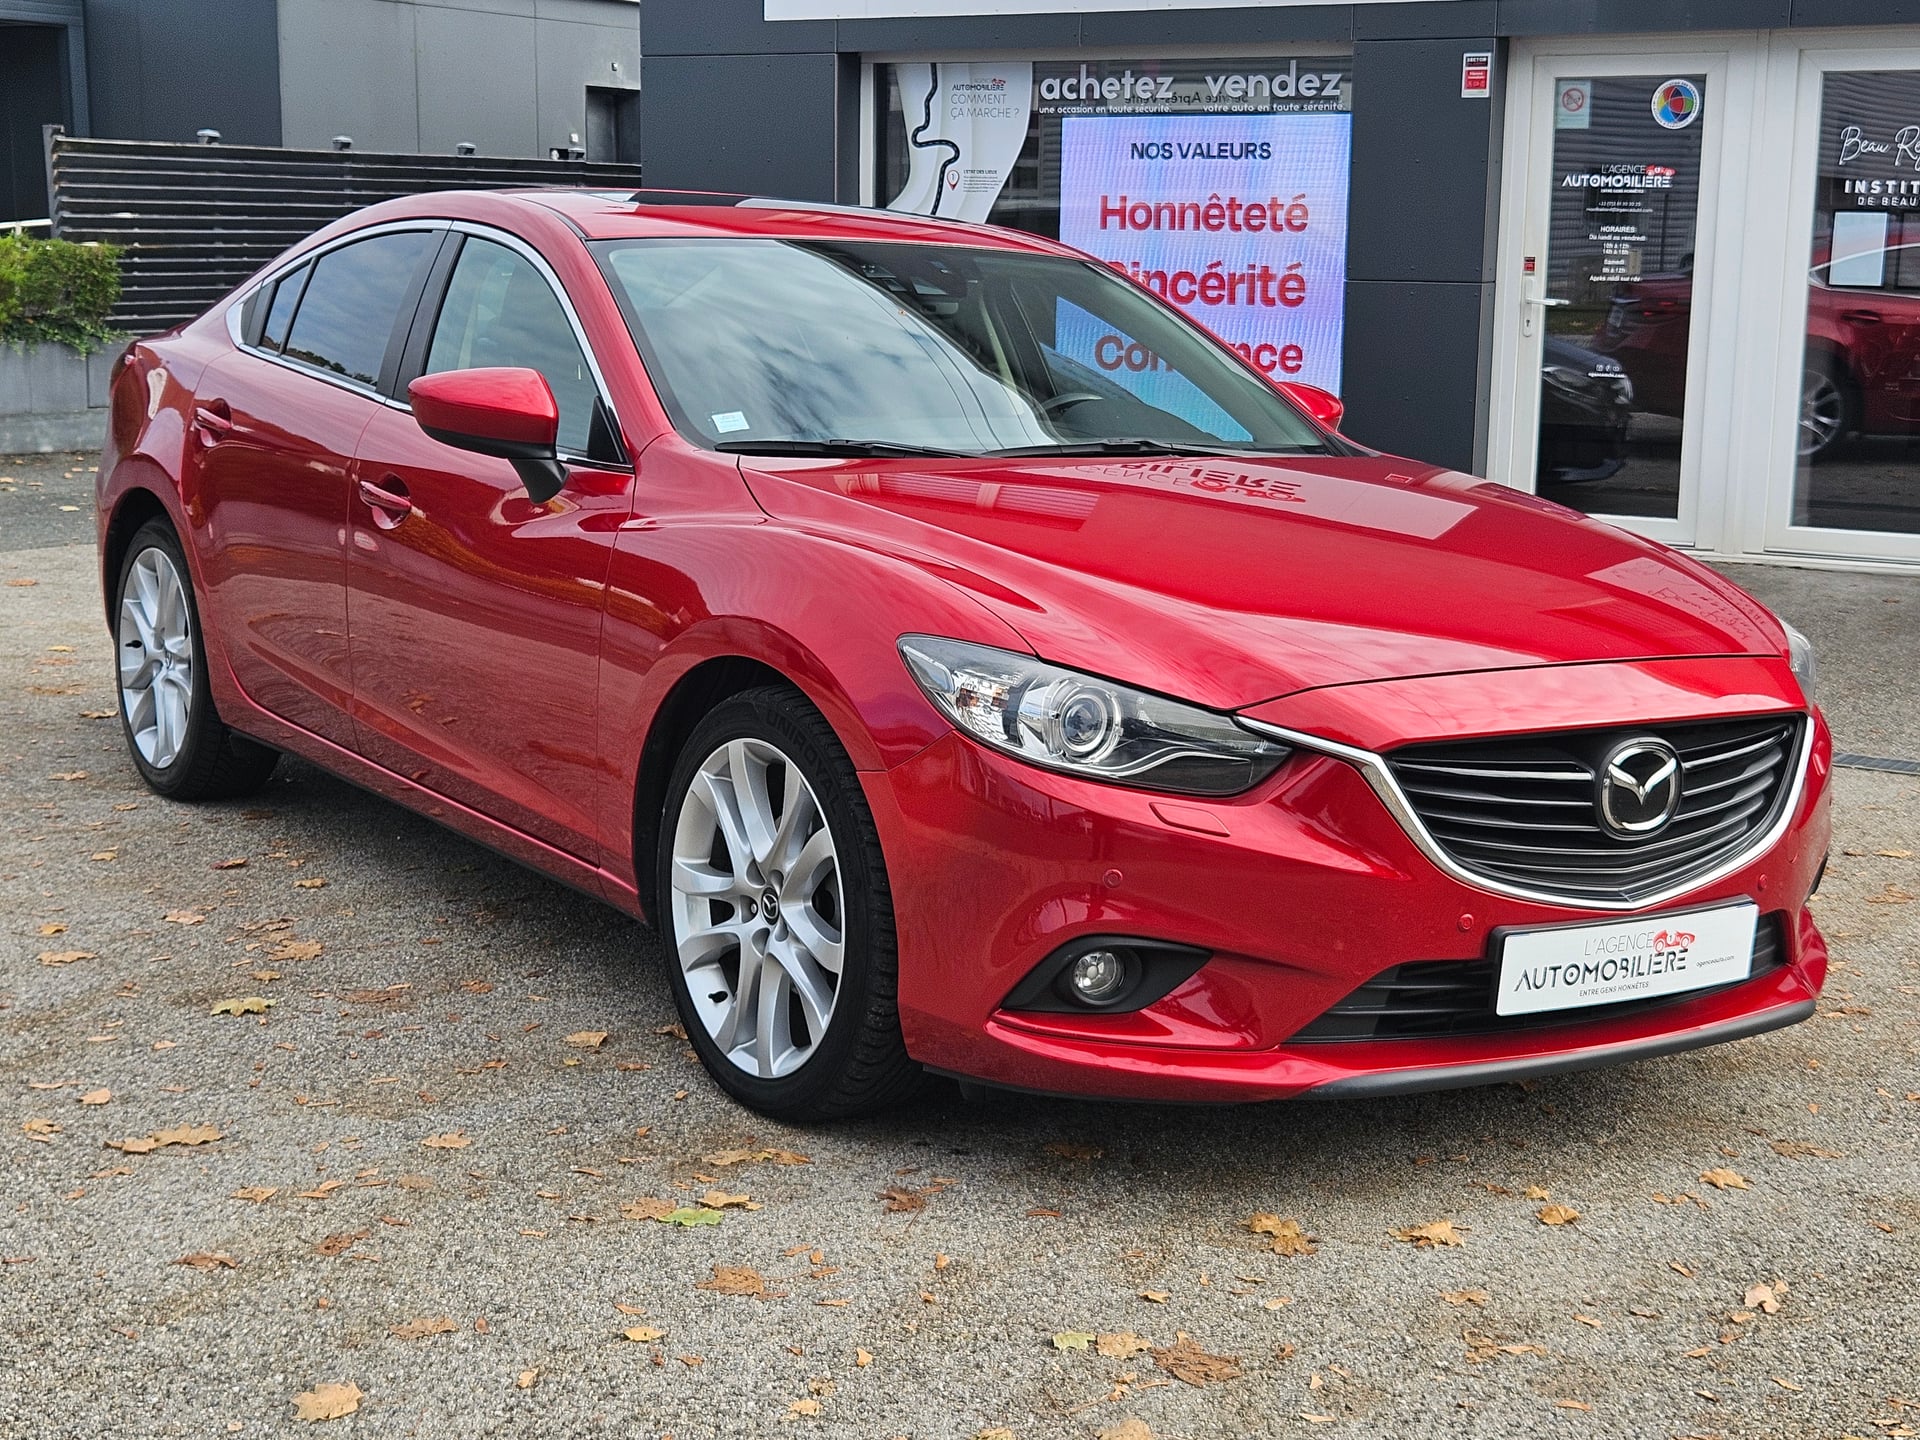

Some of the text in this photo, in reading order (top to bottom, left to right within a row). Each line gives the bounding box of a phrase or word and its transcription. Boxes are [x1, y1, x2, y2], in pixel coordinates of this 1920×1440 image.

[1040, 60, 1342, 100] achetez vendez
[951, 94, 1007, 104] COMMENT
[1203, 104, 1229, 112] votre
[1231, 104, 1254, 112] auto
[1273, 103, 1300, 112] toute
[1303, 100, 1346, 111] sérénité.
[951, 108, 1020, 120] ÇA MARCHE ?
[1039, 106, 1055, 114] une
[1057, 104, 1091, 114] occasion
[1108, 104, 1132, 113] toute
[1134, 103, 1172, 113] sécurité.
[1130, 142, 1272, 161] NOS VALEURS
[1839, 125, 1920, 171] Beau Re
[1601, 164, 1646, 174] L'AGENCE
[1845, 180, 1920, 194] INSTIT
[1858, 196, 1917, 206] DE BEAU
[1100, 192, 1309, 232] Honnêteté
[766, 710, 841, 818] UNIROYAL
[1584, 931, 1655, 956] L'AGENCE
[1579, 981, 1649, 997] ENTRE GENS HONNÊTES
